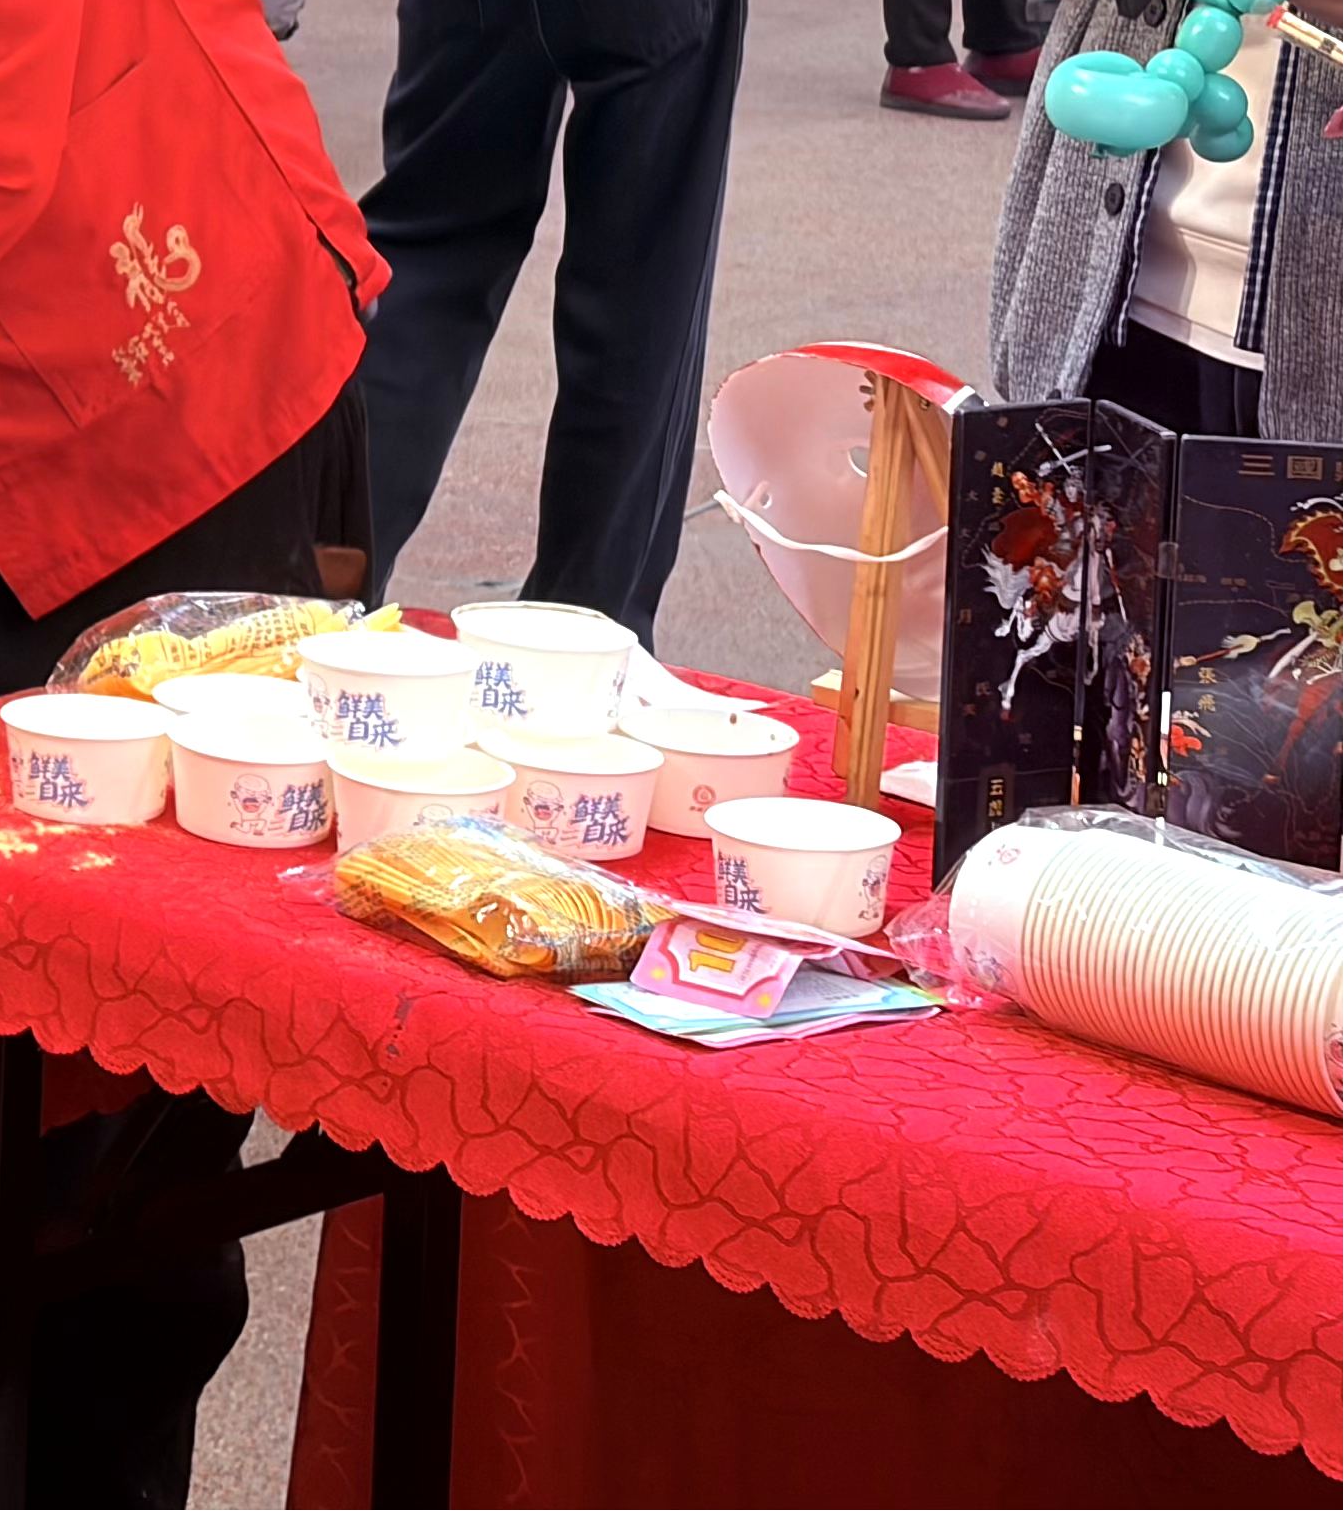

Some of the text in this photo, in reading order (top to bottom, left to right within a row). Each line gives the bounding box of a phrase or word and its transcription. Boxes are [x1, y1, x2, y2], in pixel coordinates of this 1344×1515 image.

[336, 689, 384, 720] 鲜美
[348, 718, 400, 747] 自来
[29, 750, 73, 781] 鲜美
[38, 780, 88, 808] 自来
[570, 792, 623, 824] 鲜美
[582, 817, 630, 847] 自来
